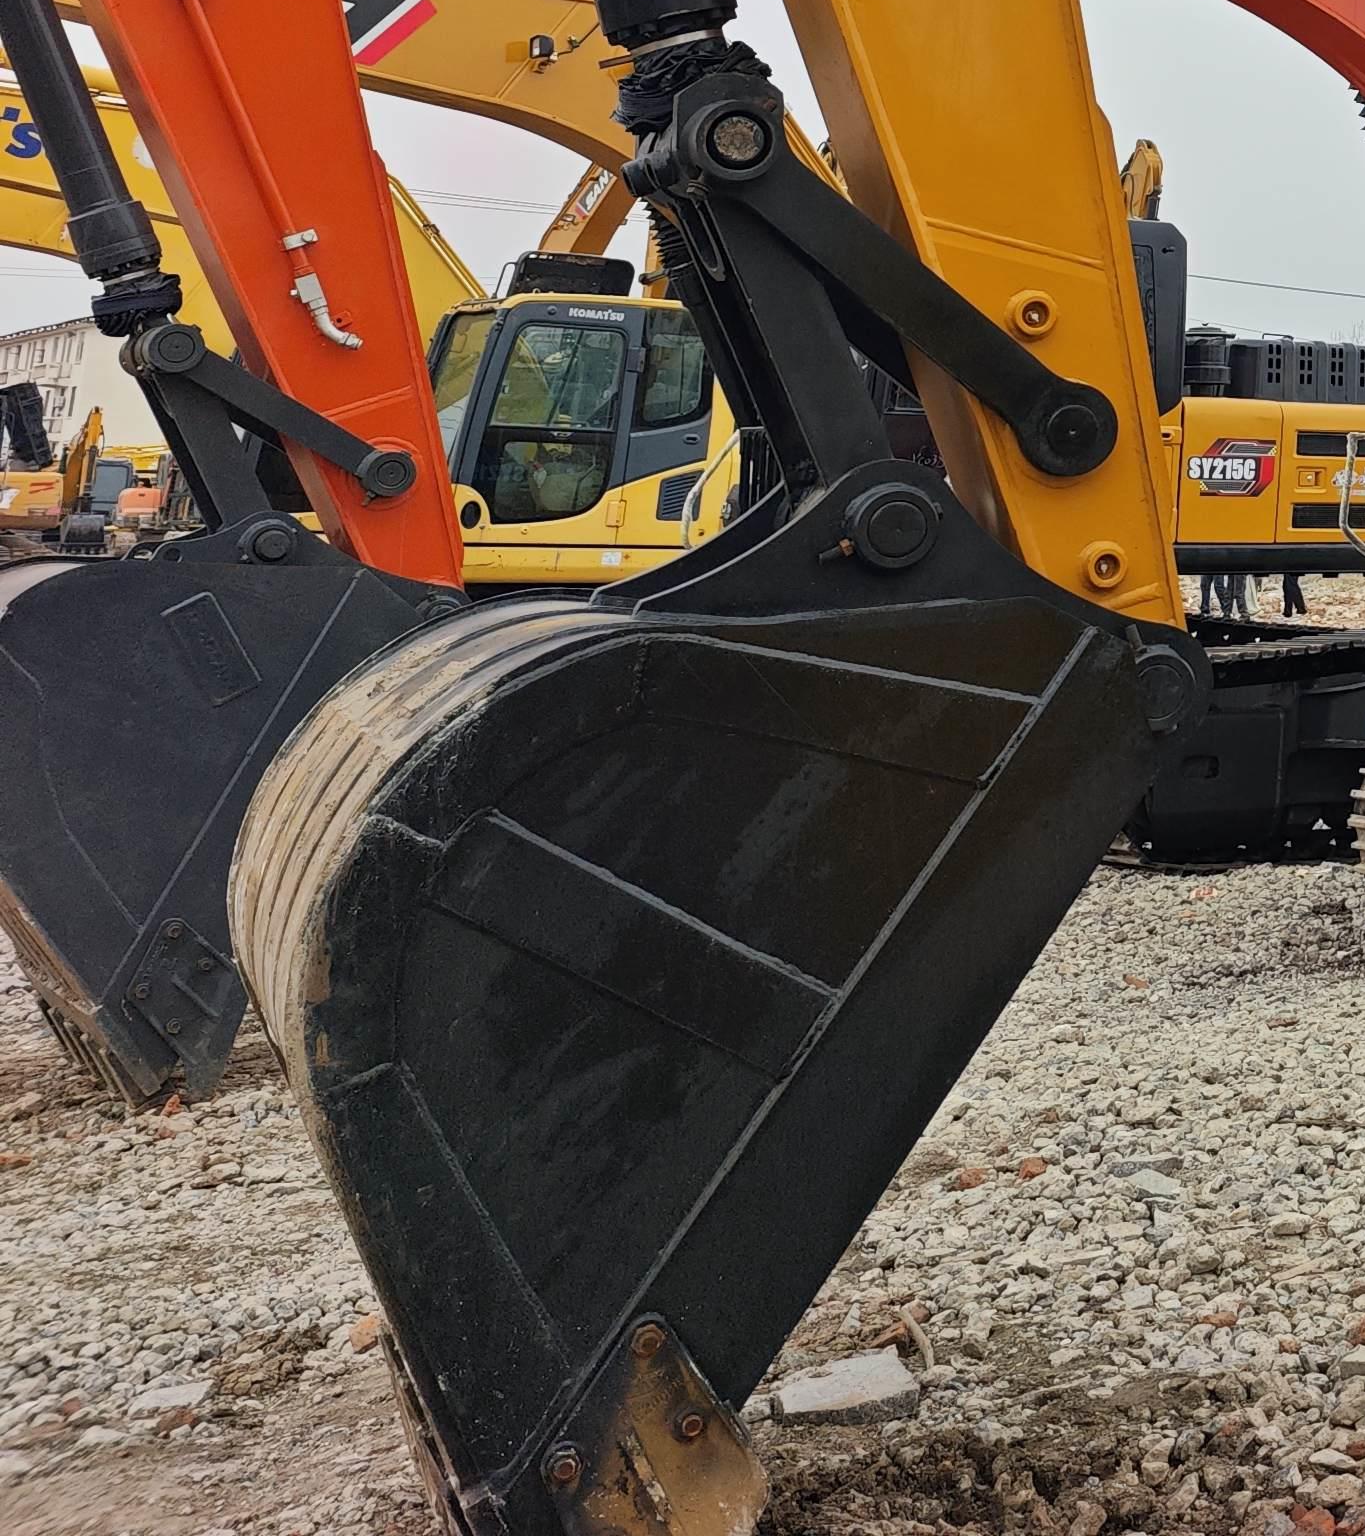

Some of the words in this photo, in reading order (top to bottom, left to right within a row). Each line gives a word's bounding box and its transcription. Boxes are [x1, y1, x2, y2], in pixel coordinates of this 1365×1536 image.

[585, 169, 614, 211] SAN
[568, 307, 625, 322] KOMATSU
[1188, 456, 1257, 481] SY215C
